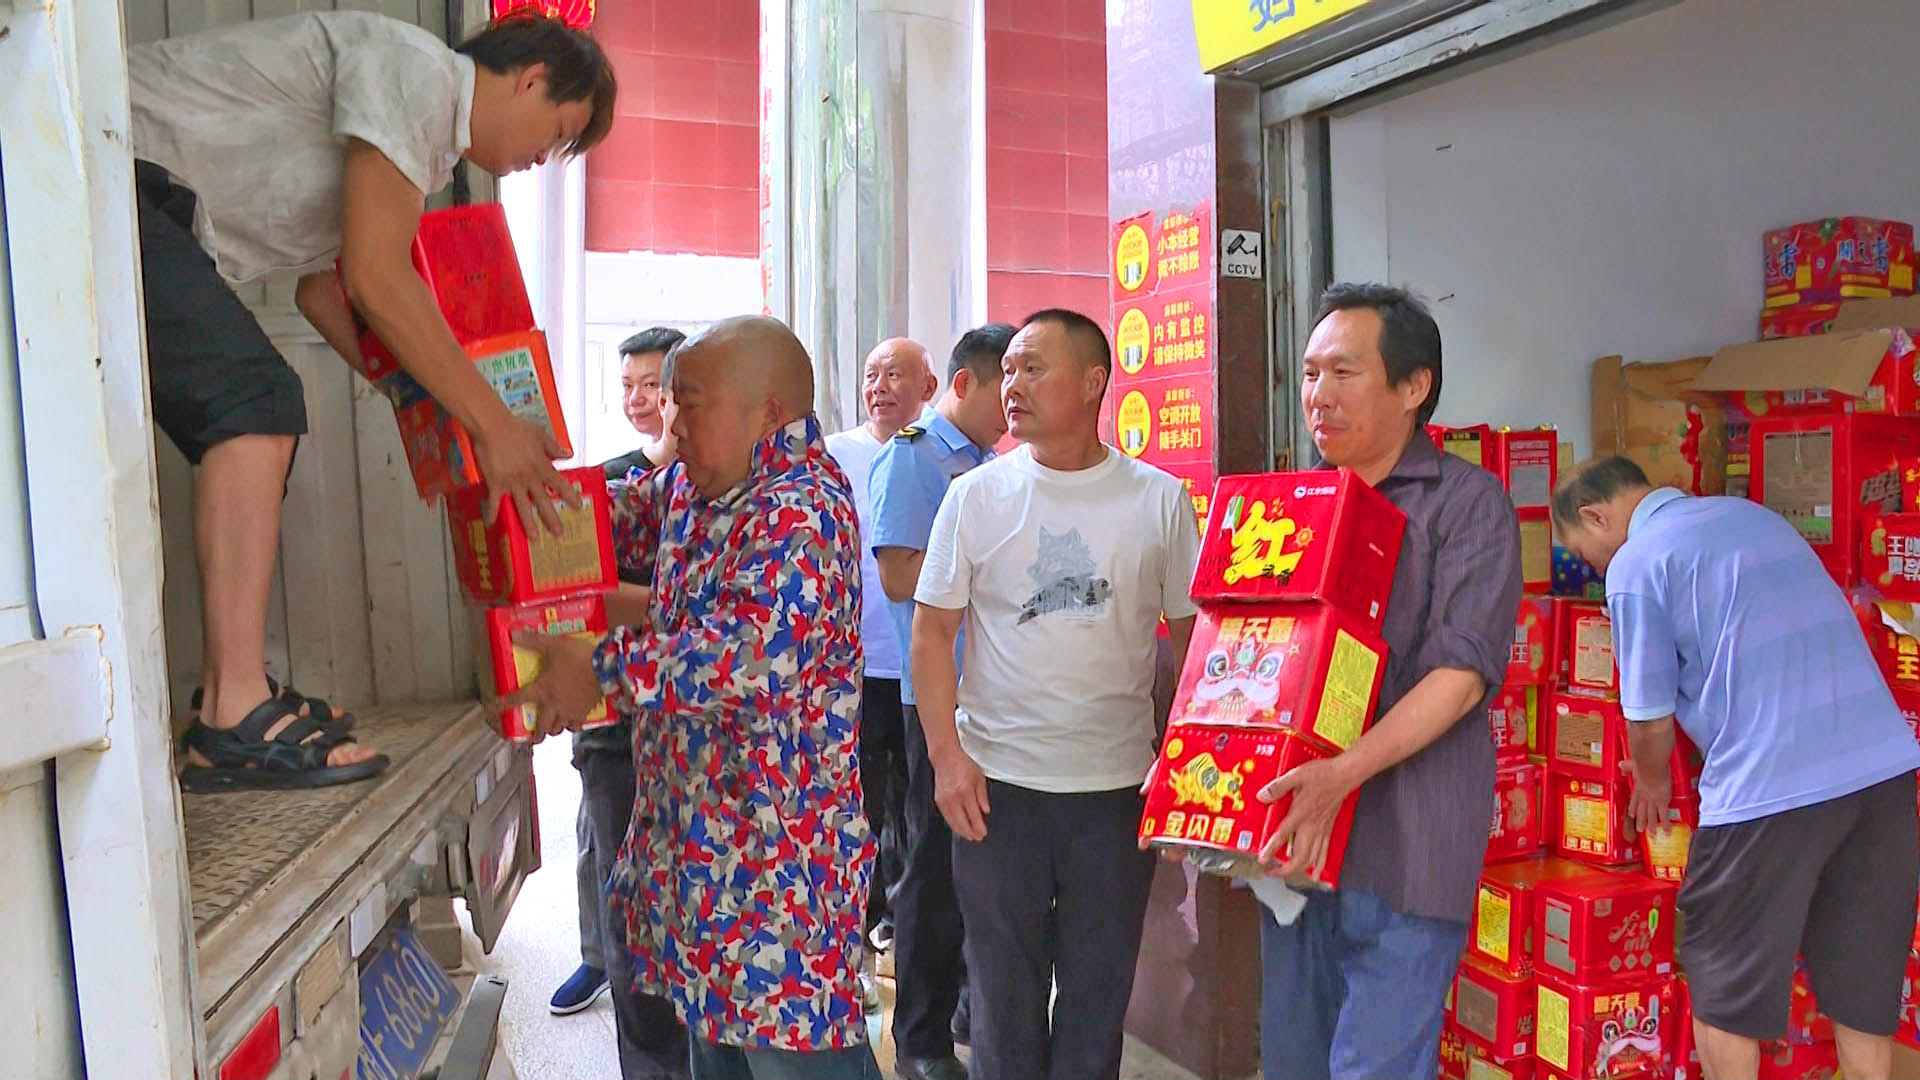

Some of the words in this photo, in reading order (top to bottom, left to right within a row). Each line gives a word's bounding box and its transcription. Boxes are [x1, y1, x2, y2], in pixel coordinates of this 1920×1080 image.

[1157, 225, 1199, 255] 小本经营
[1227, 263, 1257, 275] CCTV
[1153, 313, 1205, 343] 内有监控
[1153, 339, 1206, 367] 请保持微笑
[1159, 402, 1201, 425] 空调开放
[1159, 428, 1202, 450] 随手关门
